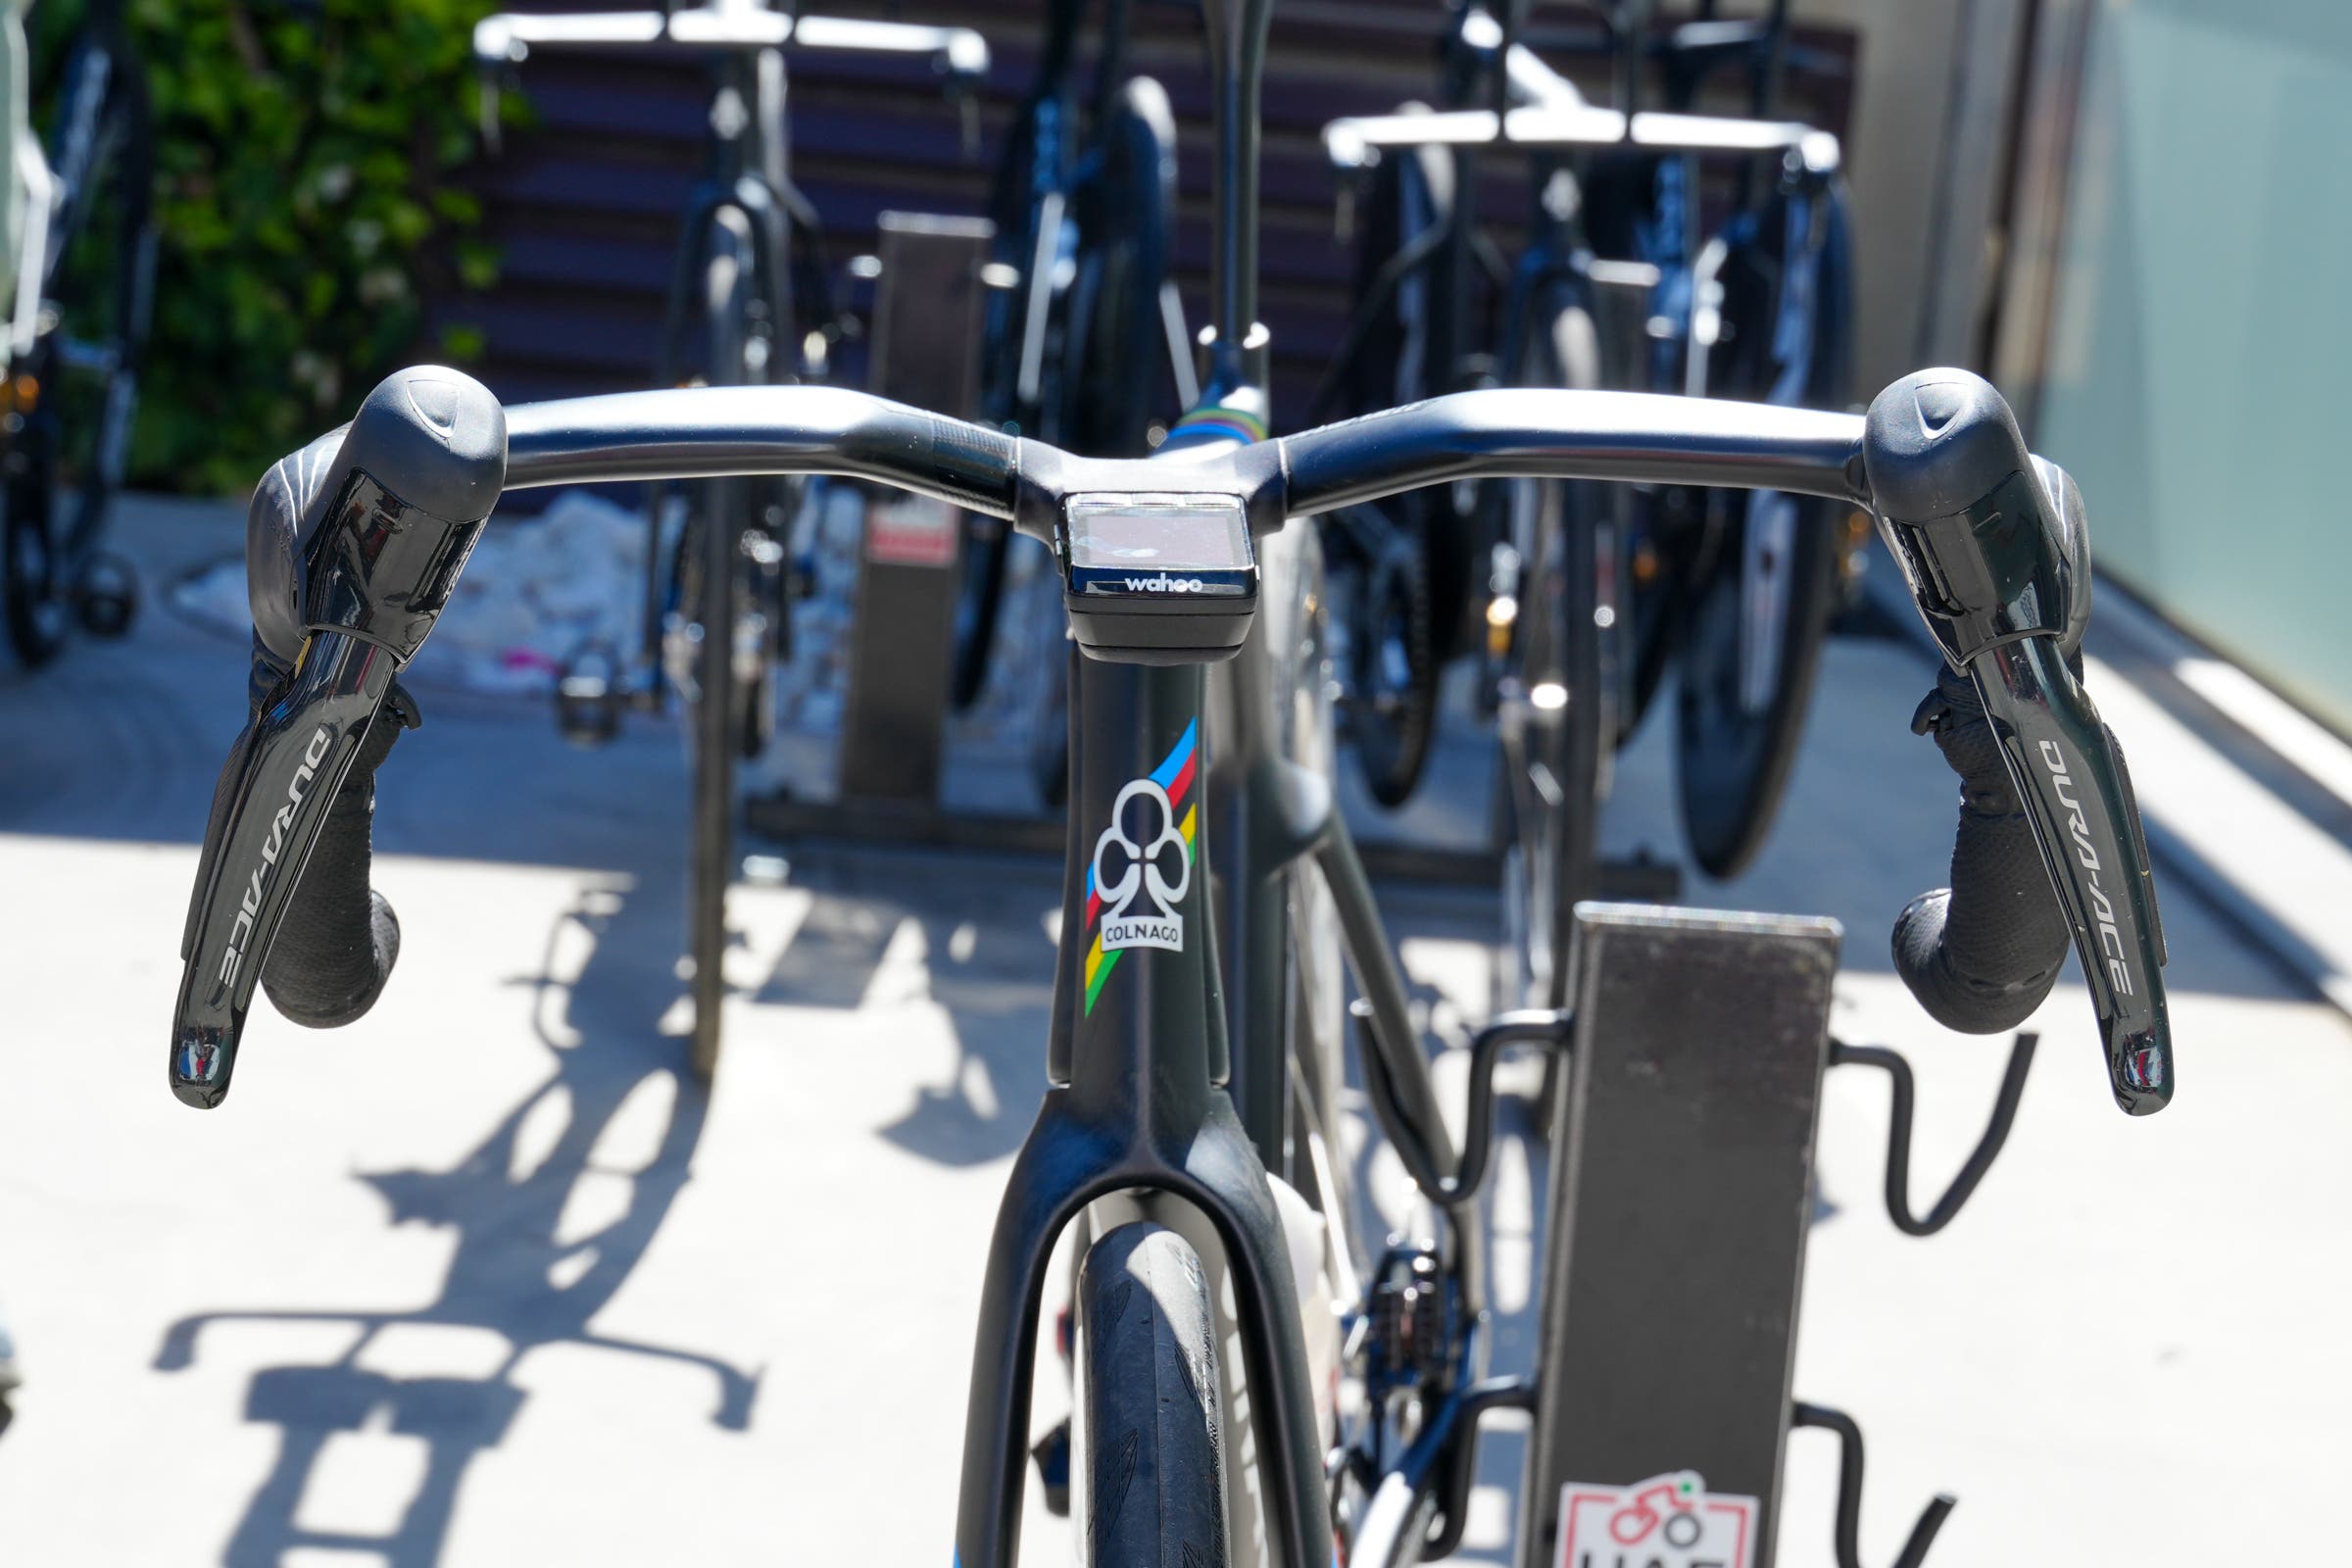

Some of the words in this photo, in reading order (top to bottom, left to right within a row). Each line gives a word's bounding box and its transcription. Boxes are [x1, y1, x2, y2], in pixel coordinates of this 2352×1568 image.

[1124, 572, 1203, 593] wahoo
[219, 727, 331, 989] DURA-ACE
[2037, 740, 2133, 997] DURA-ACE
[1105, 924, 1179, 943] COLNAGO
